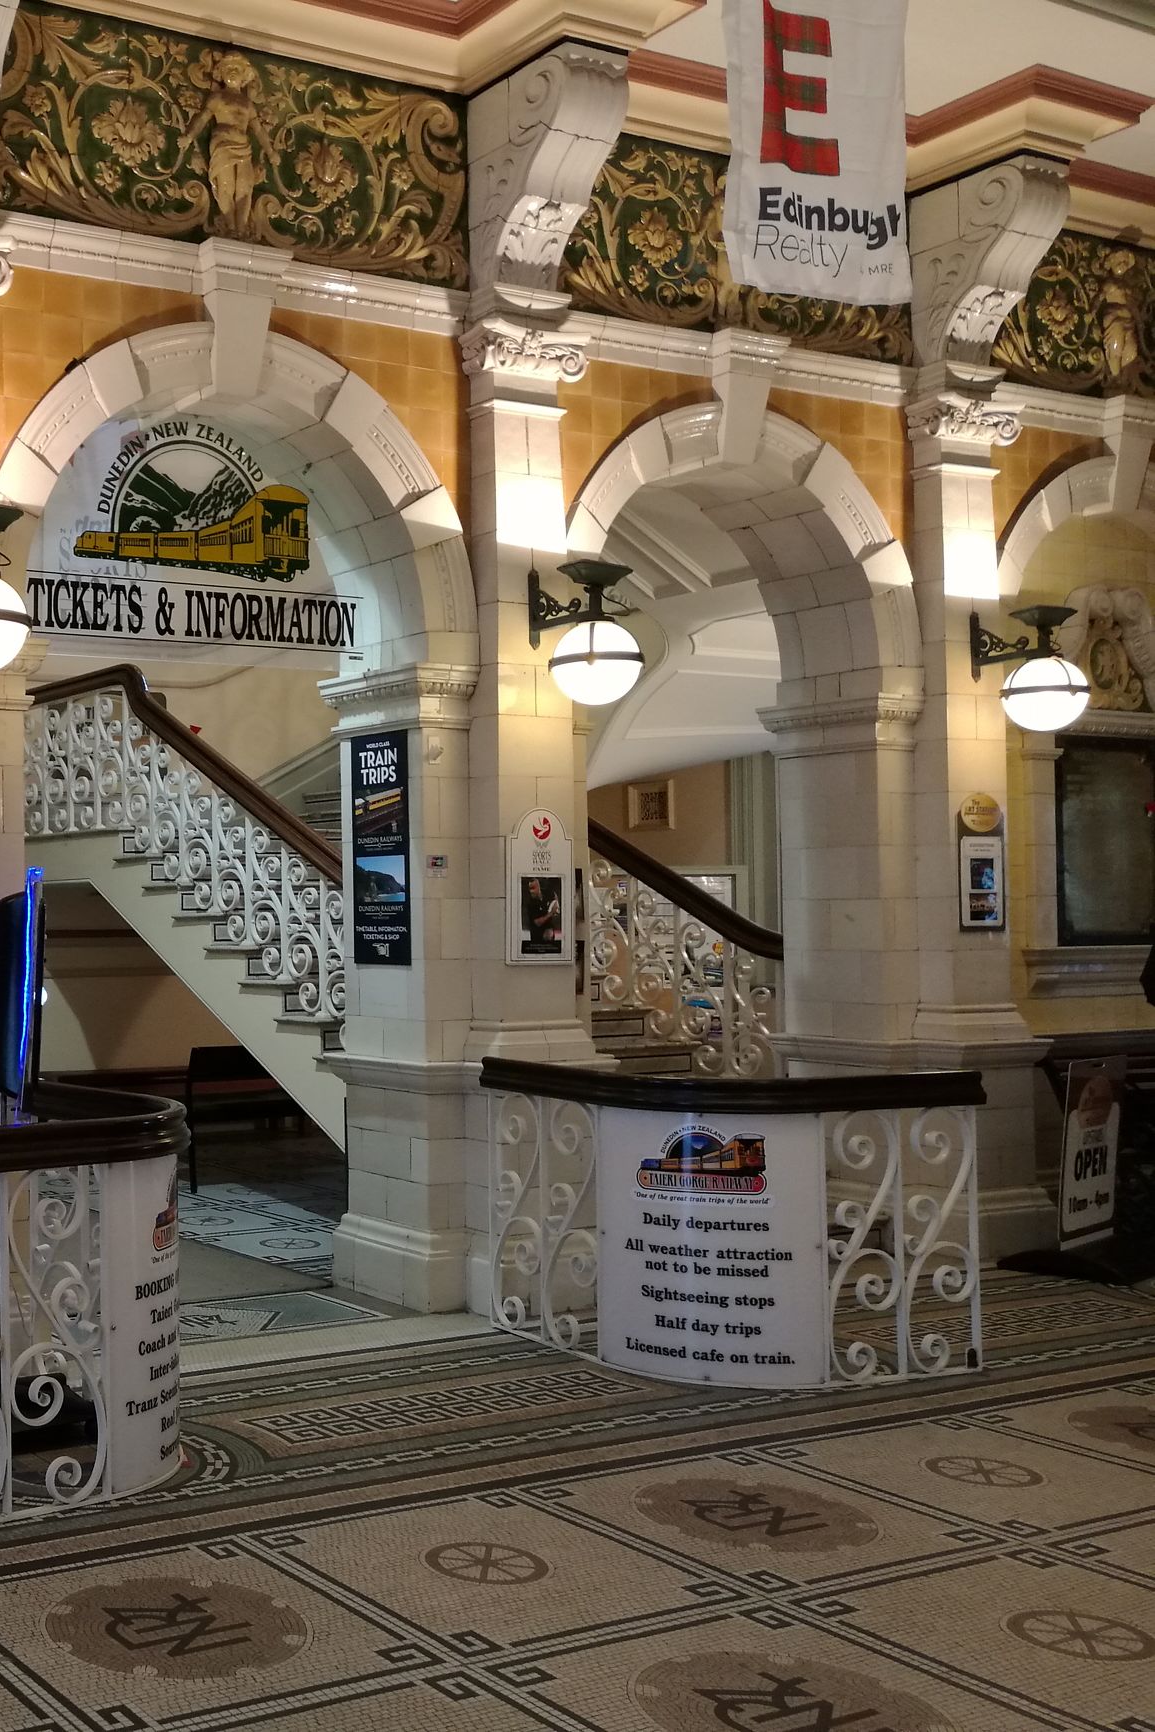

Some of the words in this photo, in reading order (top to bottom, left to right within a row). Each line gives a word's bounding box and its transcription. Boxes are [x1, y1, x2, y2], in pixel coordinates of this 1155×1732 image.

[753, 224, 848, 278] Realty
[97, 436, 144, 515] DUNEDIN
[150, 421, 189, 442] NEW
[195, 423, 264, 483] ZEALAND
[27, 577, 144, 634] TICKETS
[155, 587, 175, 636] &
[184, 589, 356, 648] INFORMATION
[359, 747, 398, 768] TRAIN
[361, 765, 397, 785] TRIPS
[357, 836, 380, 845] DUNEDIN
[380, 835, 402, 844] RAILWAYS
[1074, 1145, 1108, 1182] OPEN
[648, 1173, 677, 1187] TAIERI
[657, 1192, 668, 1200] the
[669, 1195, 687, 1203] great
[689, 1195, 706, 1203] train
[708, 1197, 725, 1205] trips
[642, 1212, 681, 1231] Daily
[686, 1217, 770, 1233] departures
[625, 1238, 644, 1252] All
[648, 1242, 709, 1259] weather
[716, 1250, 793, 1262] attraction
[645, 1260, 668, 1271] not
[673, 1262, 688, 1274] to
[693, 1263, 711, 1276] be
[716, 1265, 769, 1278] missed
[135, 1273, 174, 1300] BOOKING
[641, 1284, 729, 1308] Sightseeing
[734, 1295, 776, 1308] stops
[150, 1301, 173, 1324] Taieri
[654, 1314, 687, 1331] Half
[691, 1319, 720, 1336] day
[725, 1323, 762, 1338] trips
[138, 1334, 166, 1356] Coach
[625, 1337, 687, 1359] Licensed
[692, 1349, 725, 1363] cafe
[730, 1353, 748, 1364] on
[753, 1351, 796, 1366] train.
[125, 1396, 159, 1416] Tranz
